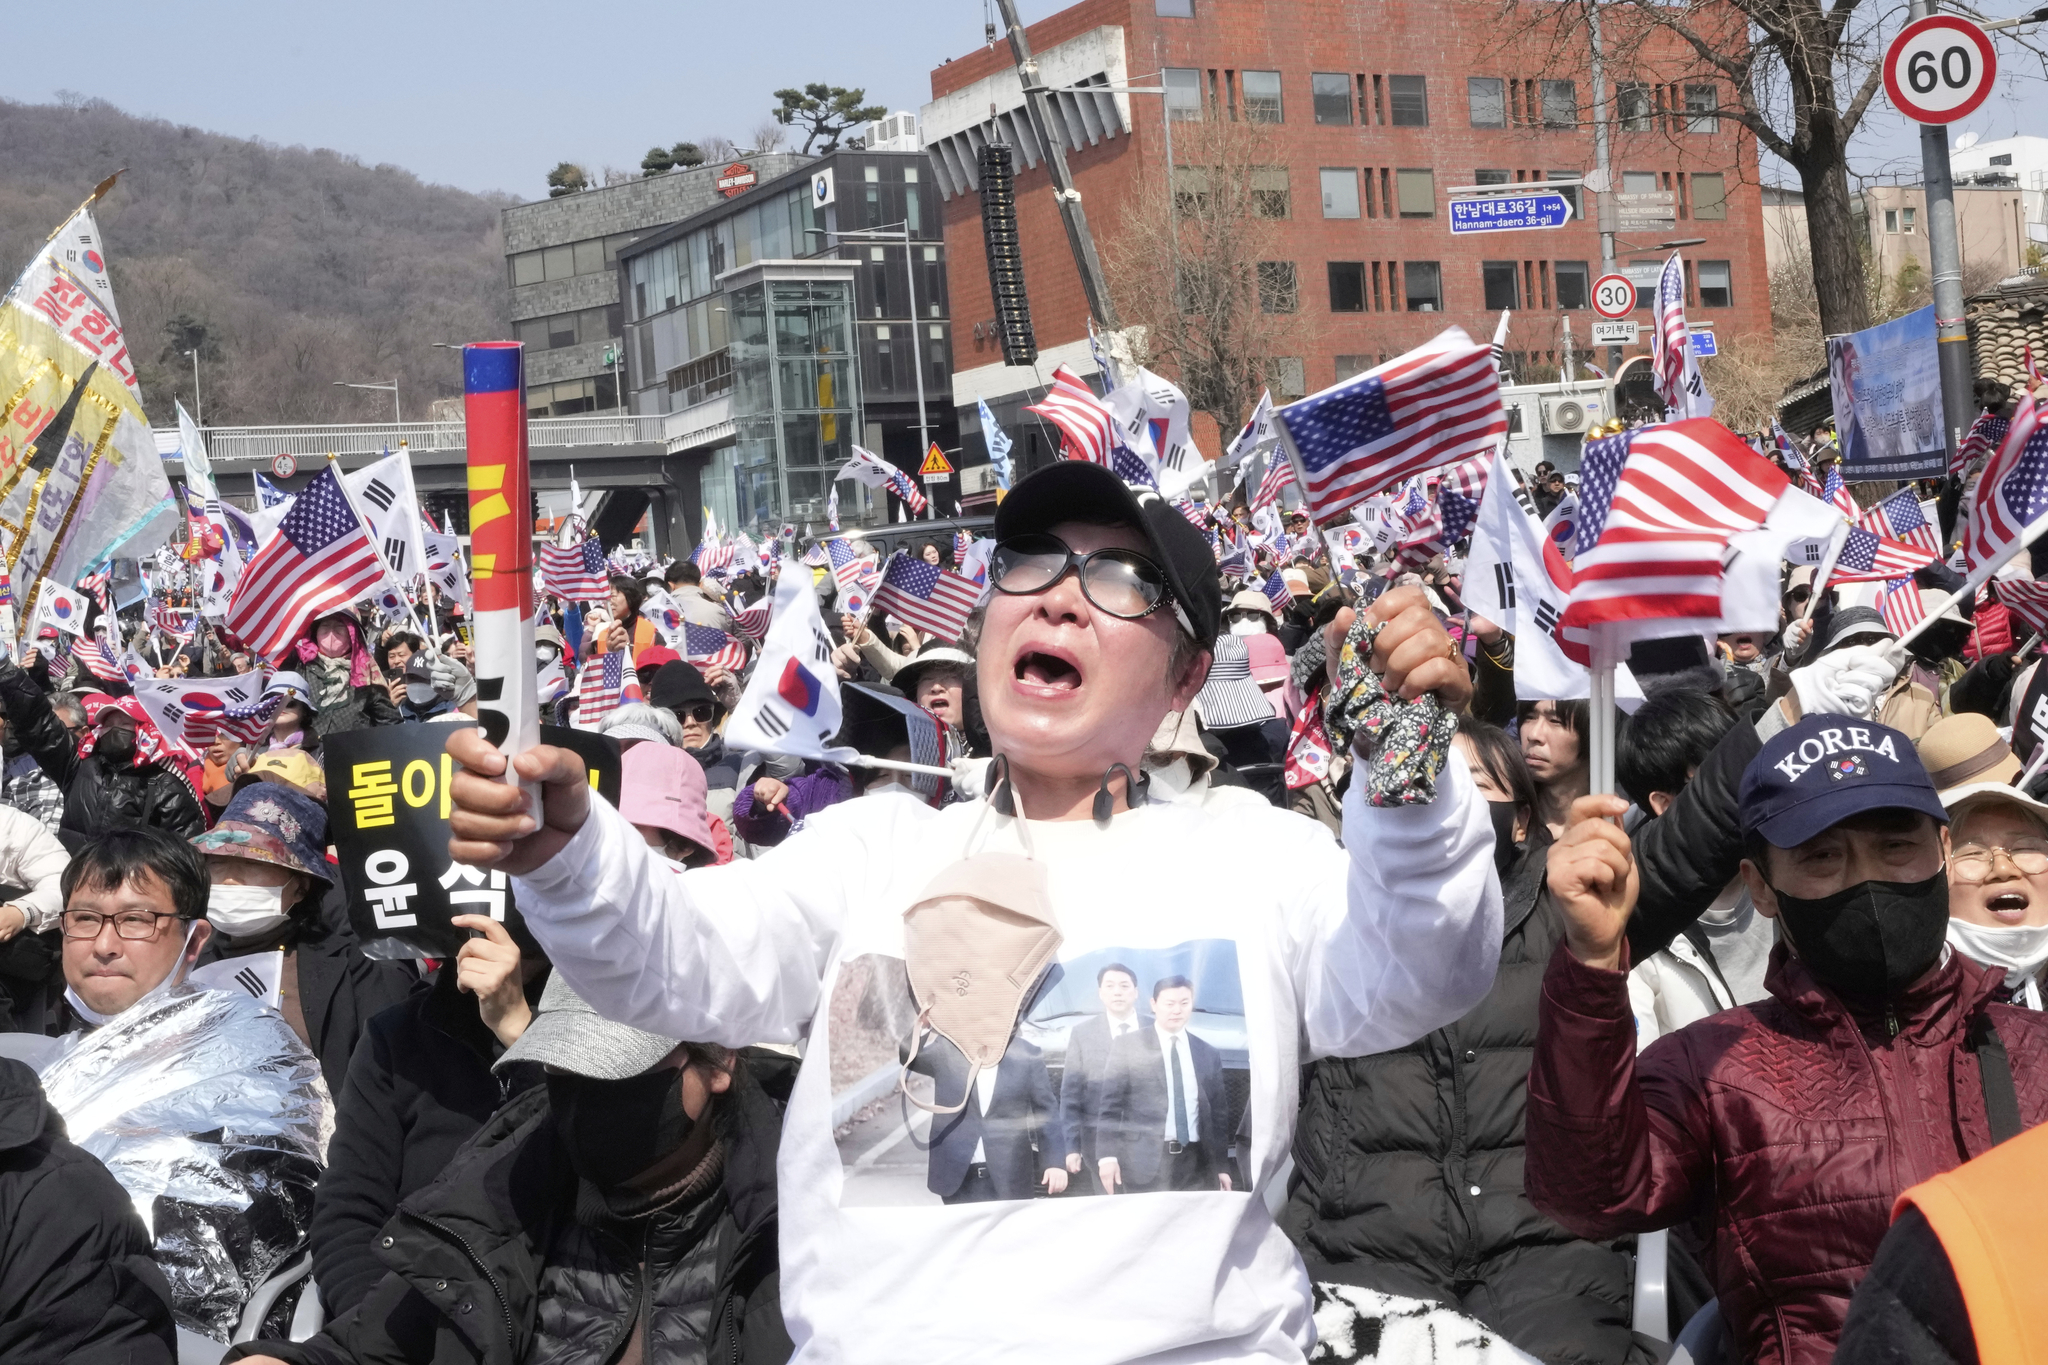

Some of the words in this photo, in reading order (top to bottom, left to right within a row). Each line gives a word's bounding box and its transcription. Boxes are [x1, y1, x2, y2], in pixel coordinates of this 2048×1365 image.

[1907, 45, 1971, 94] 60
[1454, 198, 1537, 218] 한남대로36길
[1455, 217, 1524, 230] Hannam-daero
[1525, 214, 1552, 226] 36-gil
[1601, 286, 1627, 306] 30
[1595, 323, 1635, 335] 여기부터
[1774, 727, 1899, 782] KOREA
